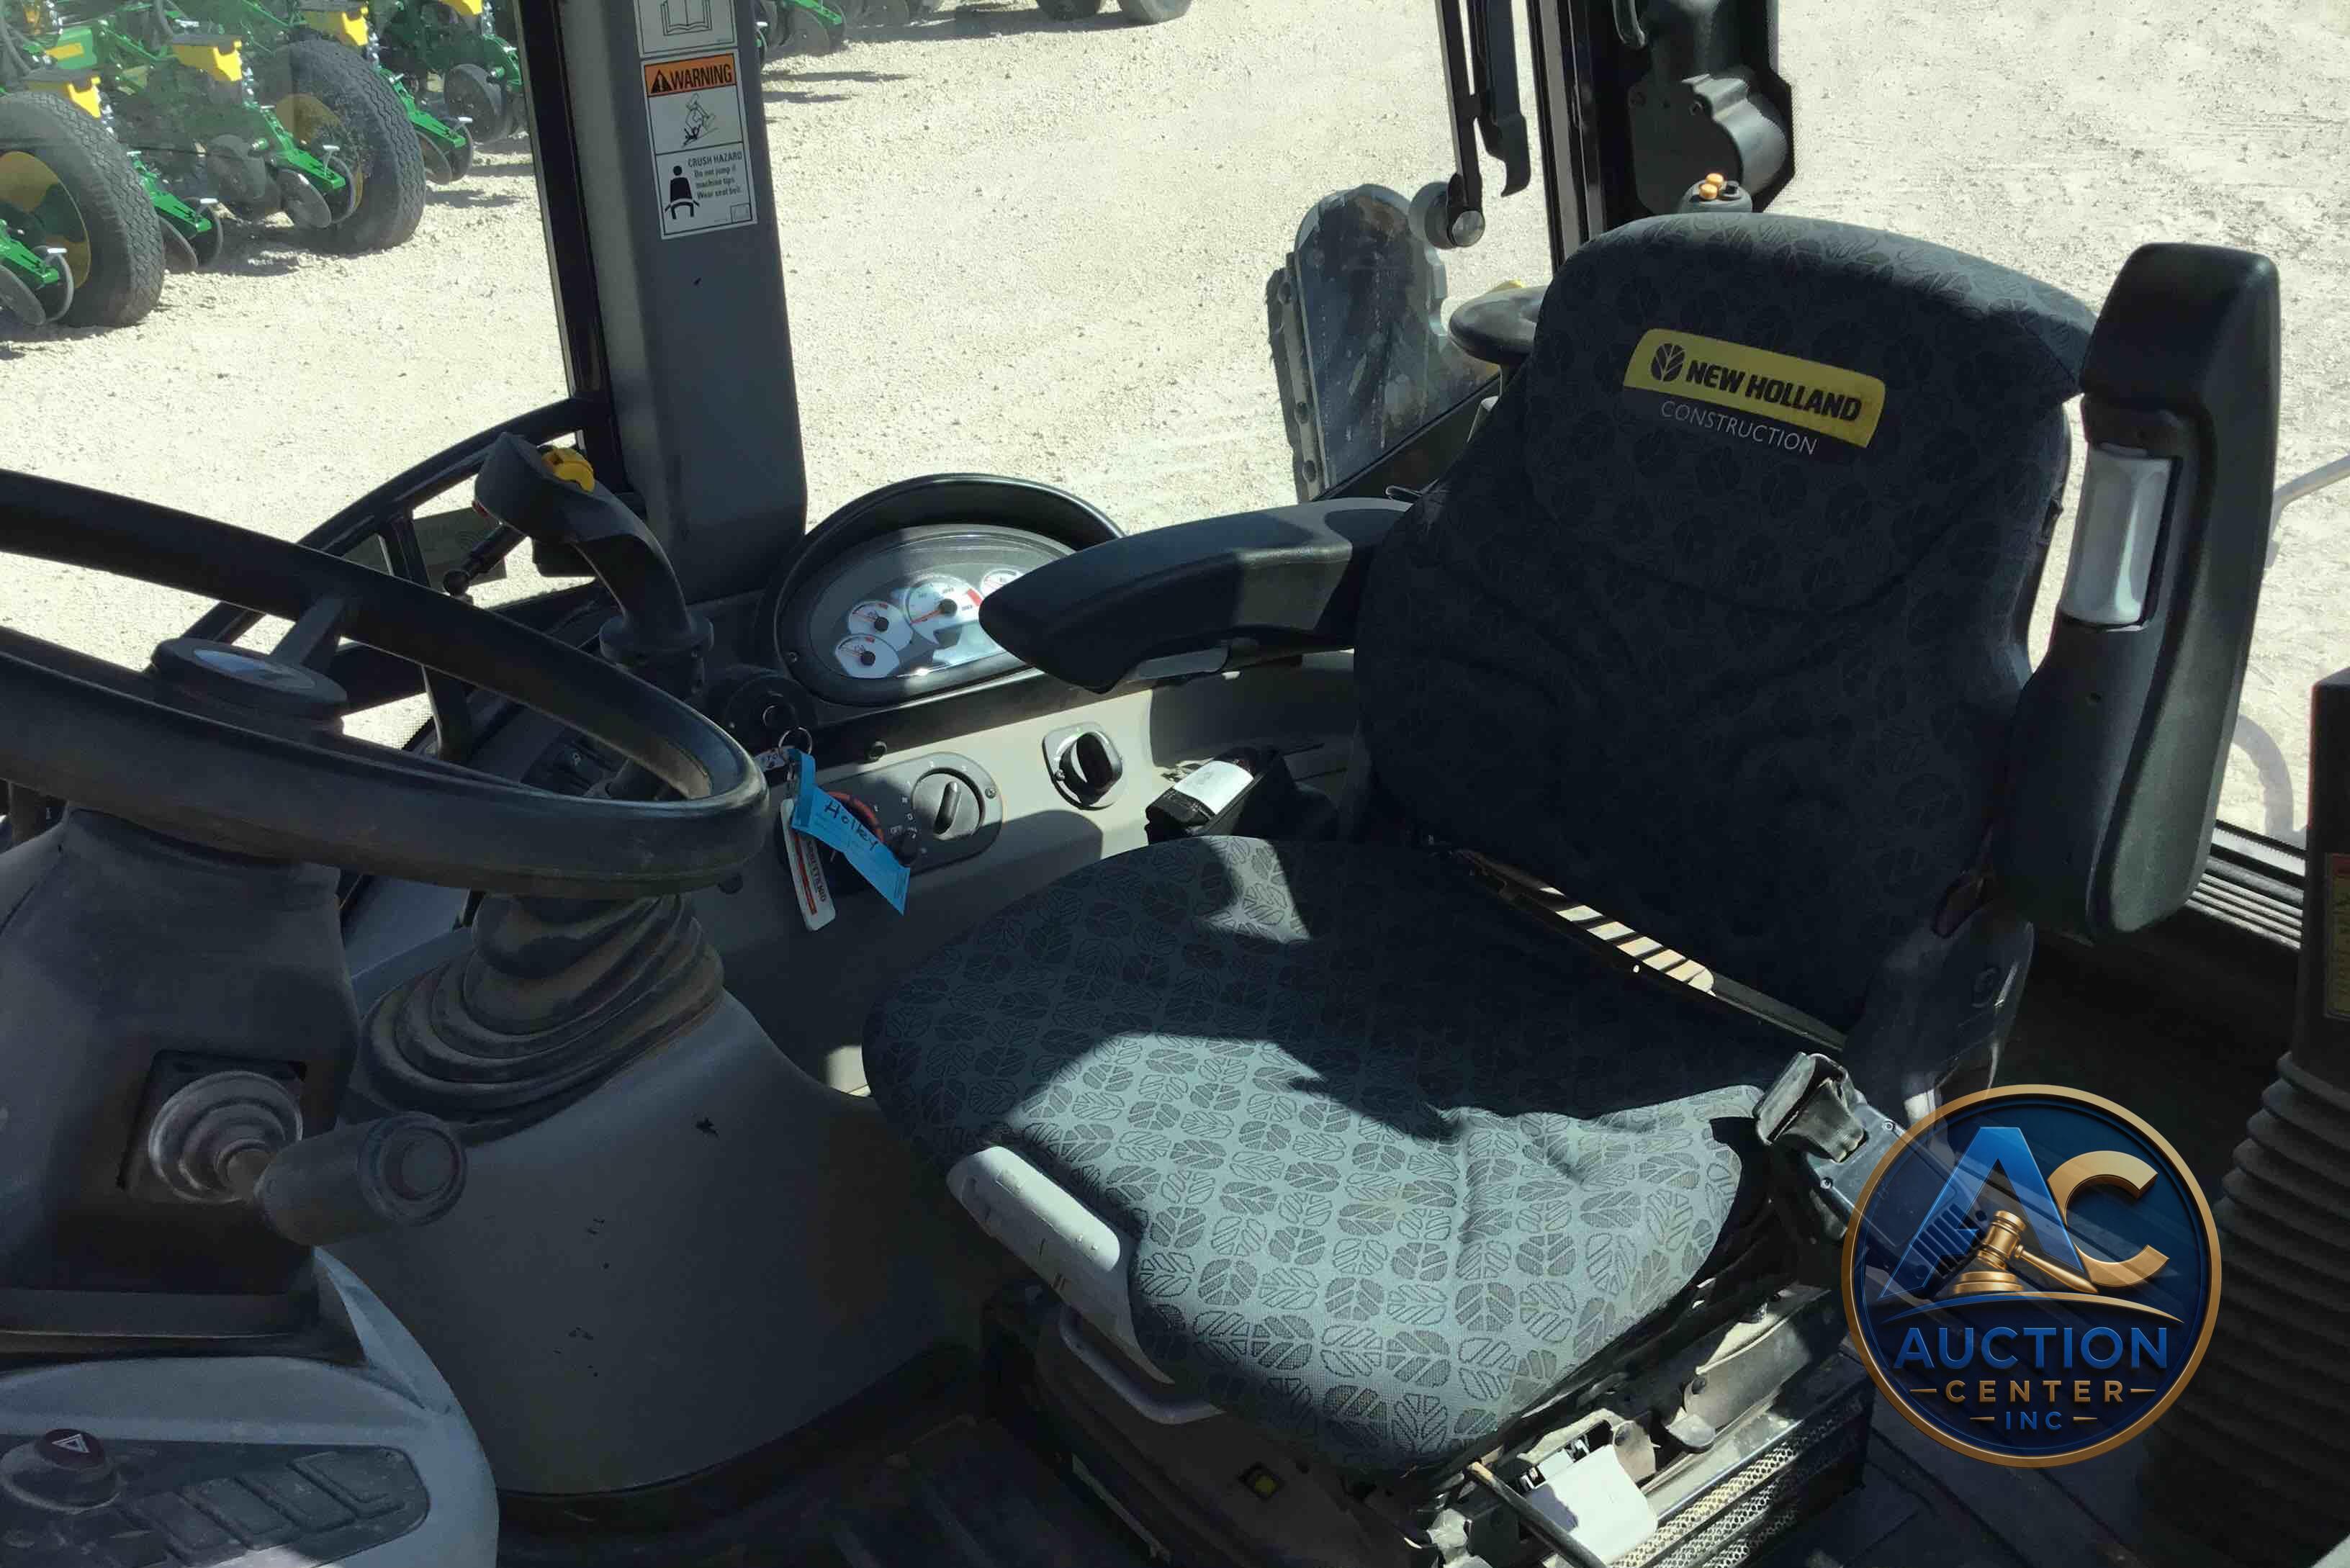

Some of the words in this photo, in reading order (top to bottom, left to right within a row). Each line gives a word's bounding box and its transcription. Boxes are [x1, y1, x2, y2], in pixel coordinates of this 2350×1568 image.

[670, 63, 732, 91] WARNING
[688, 156, 713, 168] CRUSH
[713, 150, 743, 162] HAZARD
[1686, 360, 1746, 395] NEW
[1745, 374, 1863, 422] HOLLAND
[1661, 400, 1819, 455] CONSTRUCTION
